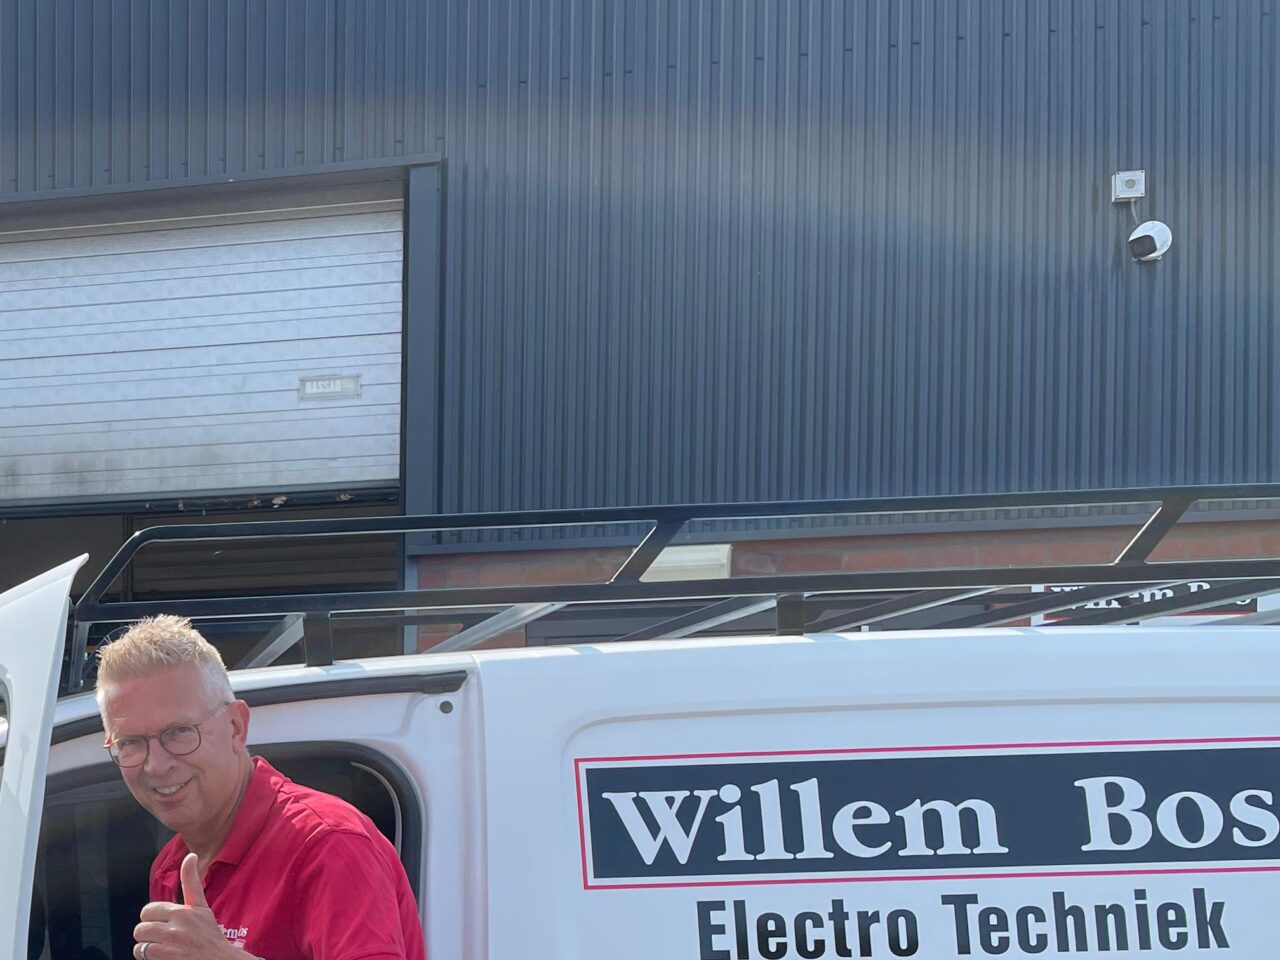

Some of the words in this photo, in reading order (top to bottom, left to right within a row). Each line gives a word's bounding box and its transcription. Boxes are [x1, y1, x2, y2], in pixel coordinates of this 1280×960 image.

[602, 777, 1009, 865] Willem
[1073, 776, 1280, 852] Bos
[941, 887, 1230, 955] Techniek
